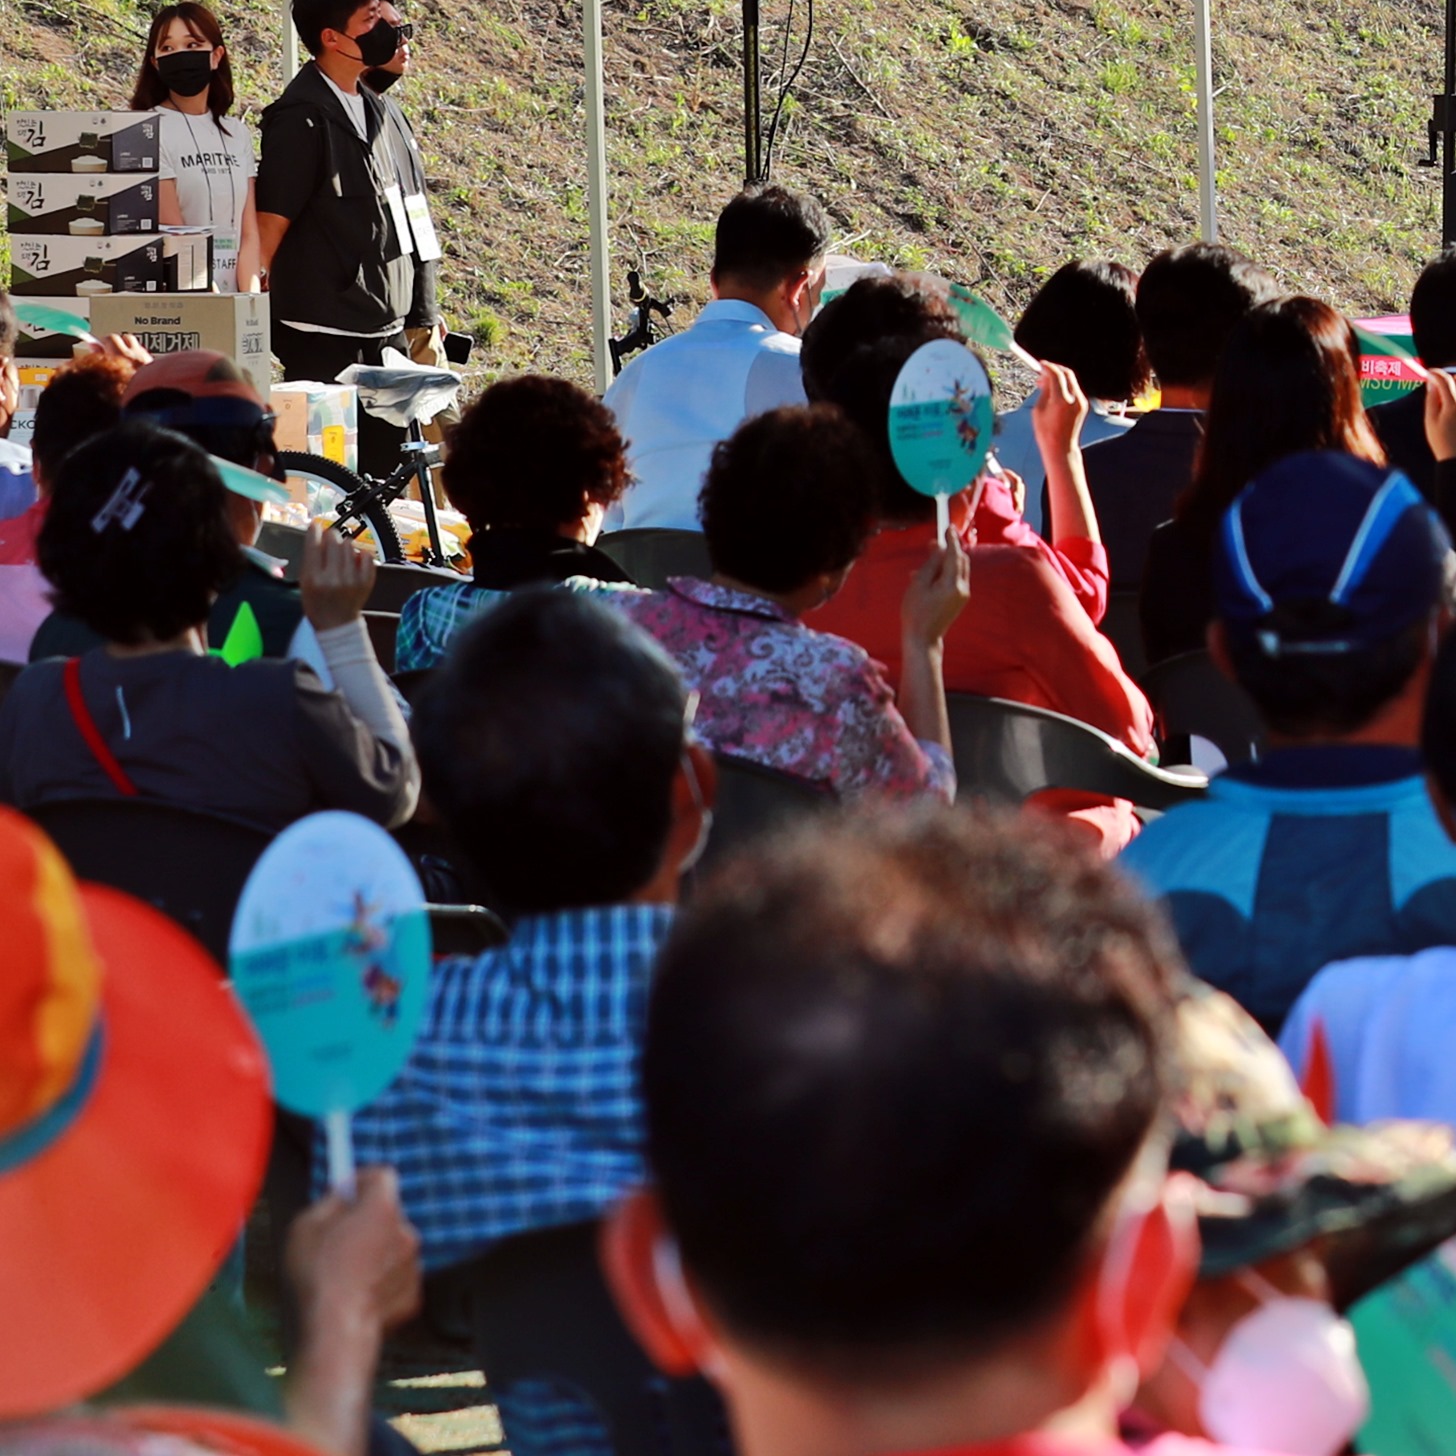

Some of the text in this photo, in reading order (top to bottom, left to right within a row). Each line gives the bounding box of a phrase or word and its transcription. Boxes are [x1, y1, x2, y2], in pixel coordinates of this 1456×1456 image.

[27, 121, 46, 147] 김
[26, 182, 45, 209] 김
[31, 244, 51, 271] 김
[212, 258, 236, 270] STAFF
[134, 316, 181, 325] No Brand
